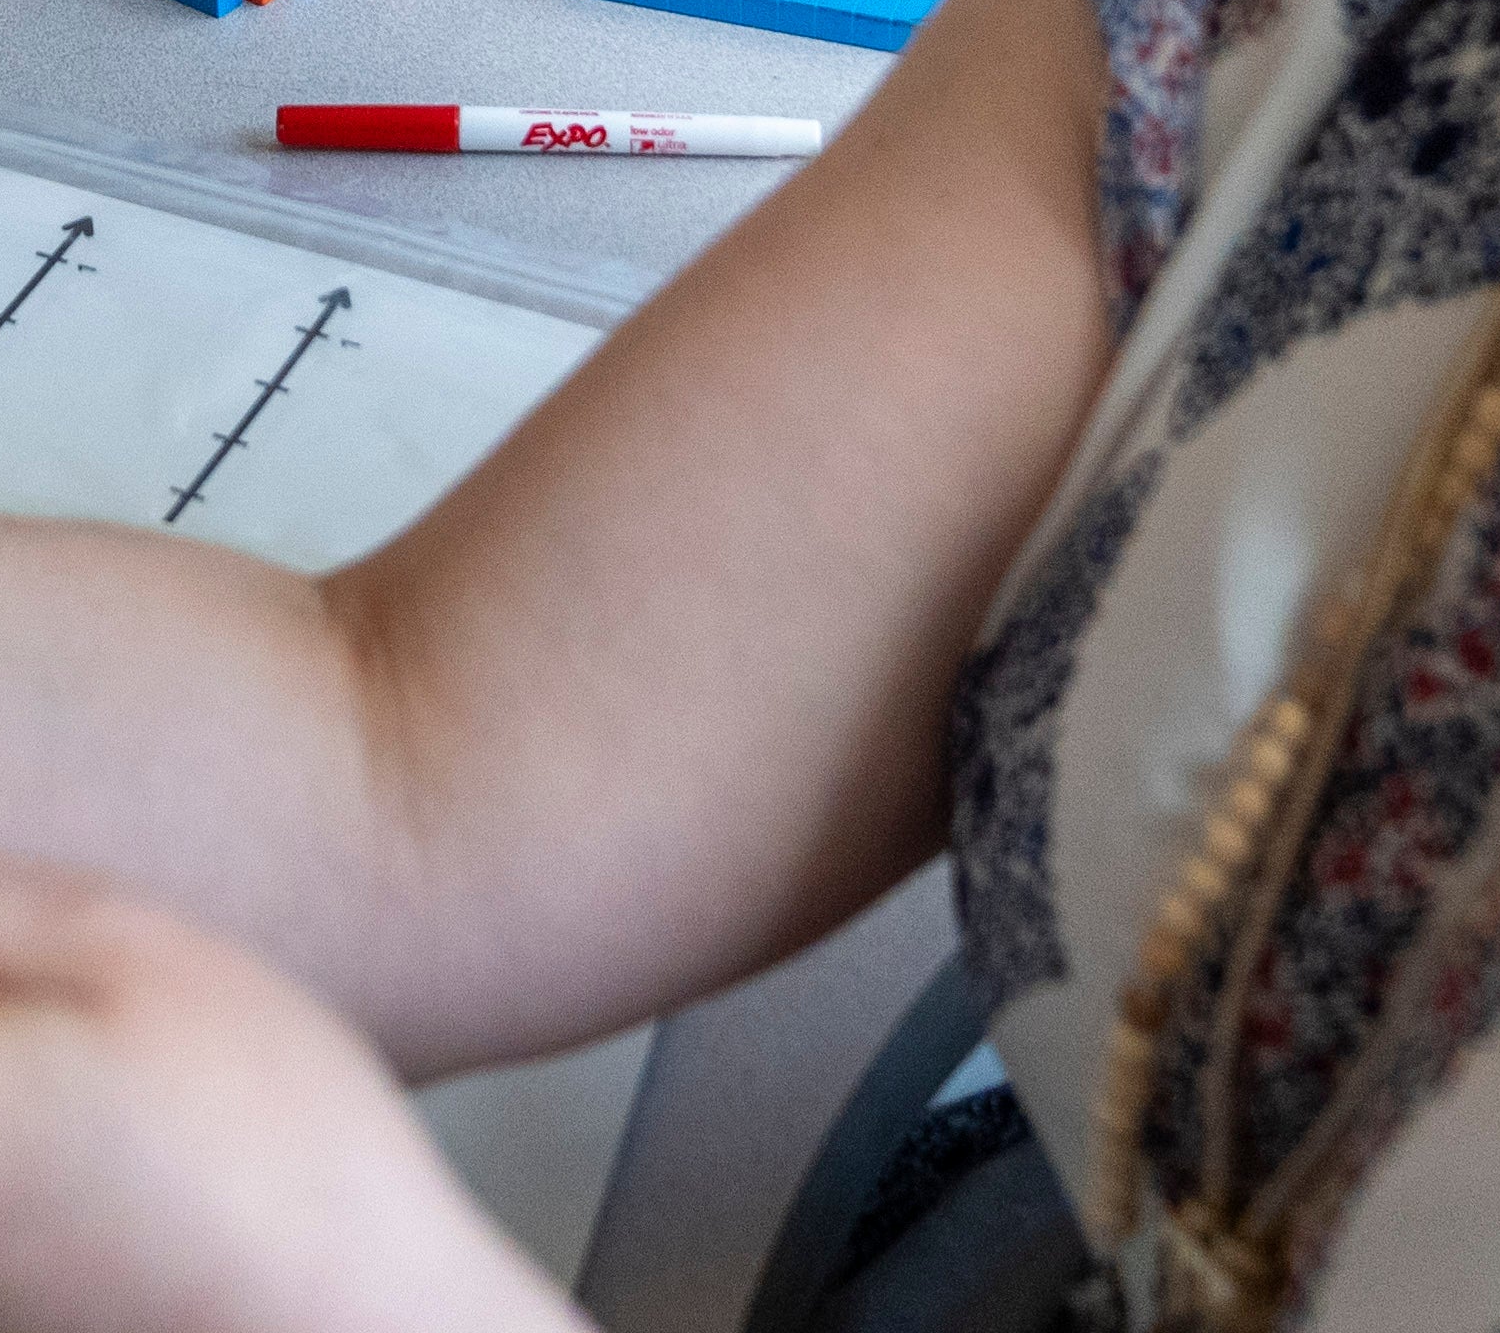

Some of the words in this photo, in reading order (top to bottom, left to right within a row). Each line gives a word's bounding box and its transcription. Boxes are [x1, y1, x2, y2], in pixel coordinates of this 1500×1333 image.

[521, 121, 608, 152] EXPO
[630, 125, 648, 136] low
[651, 126, 676, 137] odor
